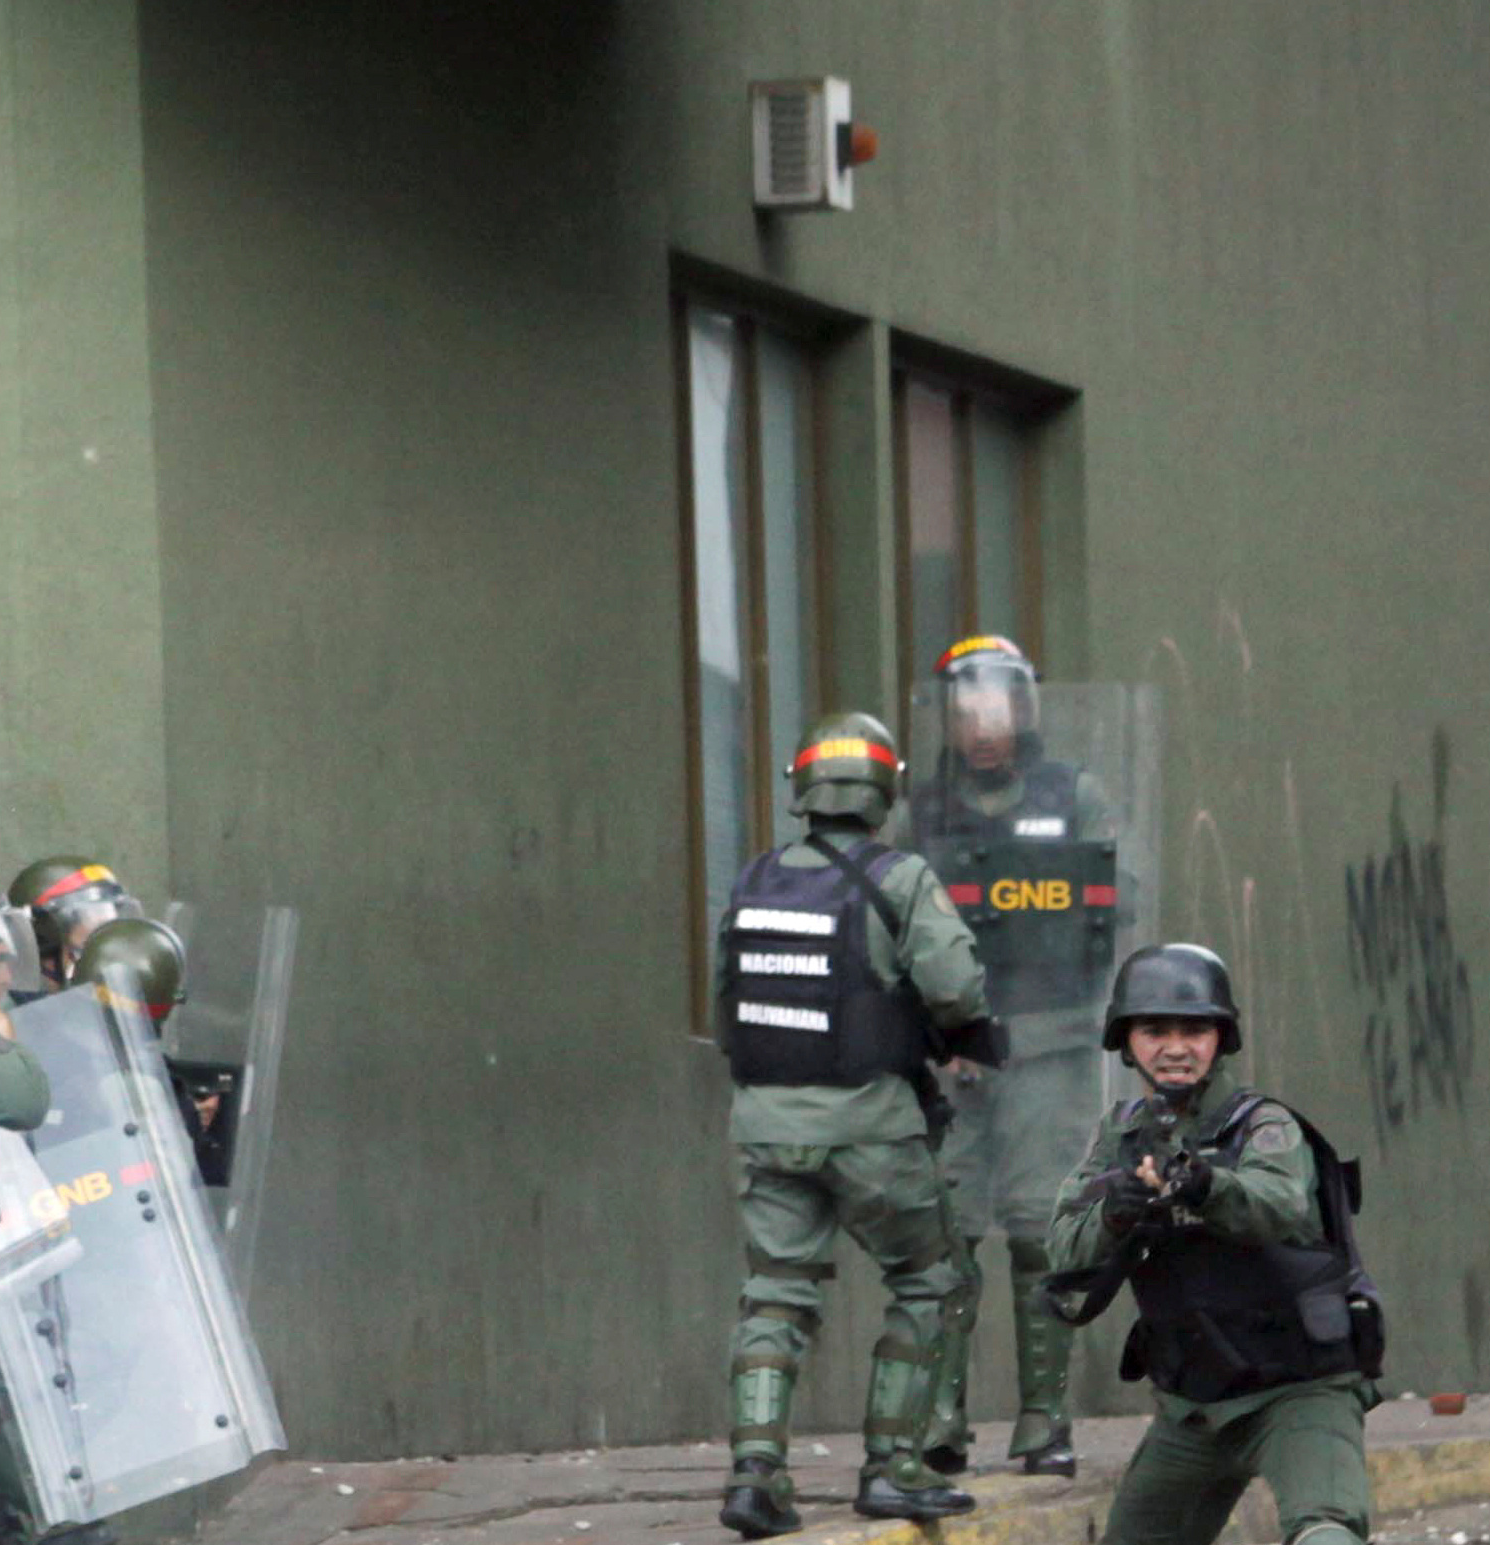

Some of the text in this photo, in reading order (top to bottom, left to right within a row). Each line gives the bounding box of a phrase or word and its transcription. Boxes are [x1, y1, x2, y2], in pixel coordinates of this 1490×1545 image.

[990, 878, 1073, 912] GNB
[739, 953, 831, 976] NACIONAL
[29, 1169, 114, 1221] GNB
